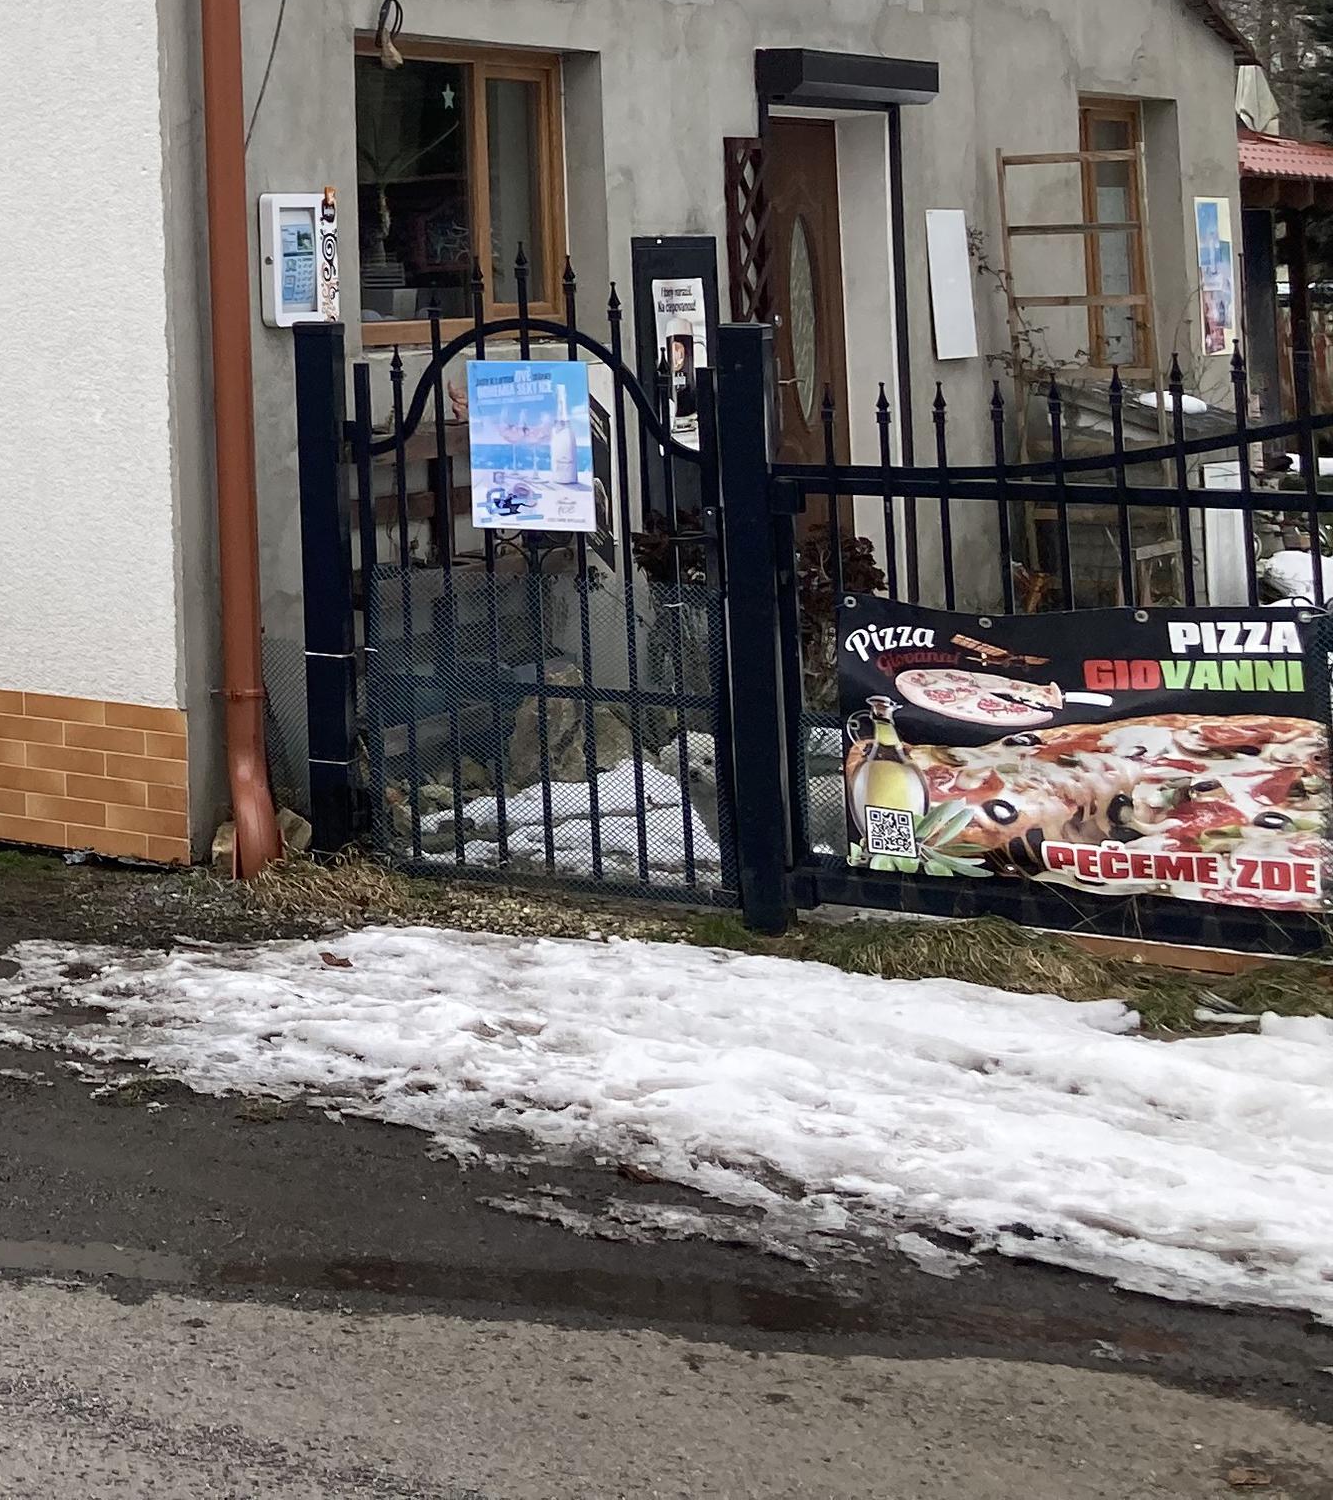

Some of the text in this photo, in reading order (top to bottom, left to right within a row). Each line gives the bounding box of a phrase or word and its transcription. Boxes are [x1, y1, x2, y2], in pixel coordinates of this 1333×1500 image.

[844, 623, 935, 661] Pizza
[1167, 621, 1302, 654] PIZZA
[876, 650, 962, 676] Giovanni
[1083, 660, 1305, 691] GIOVANNI
[1046, 844, 1317, 894] PEČEME ZDE
